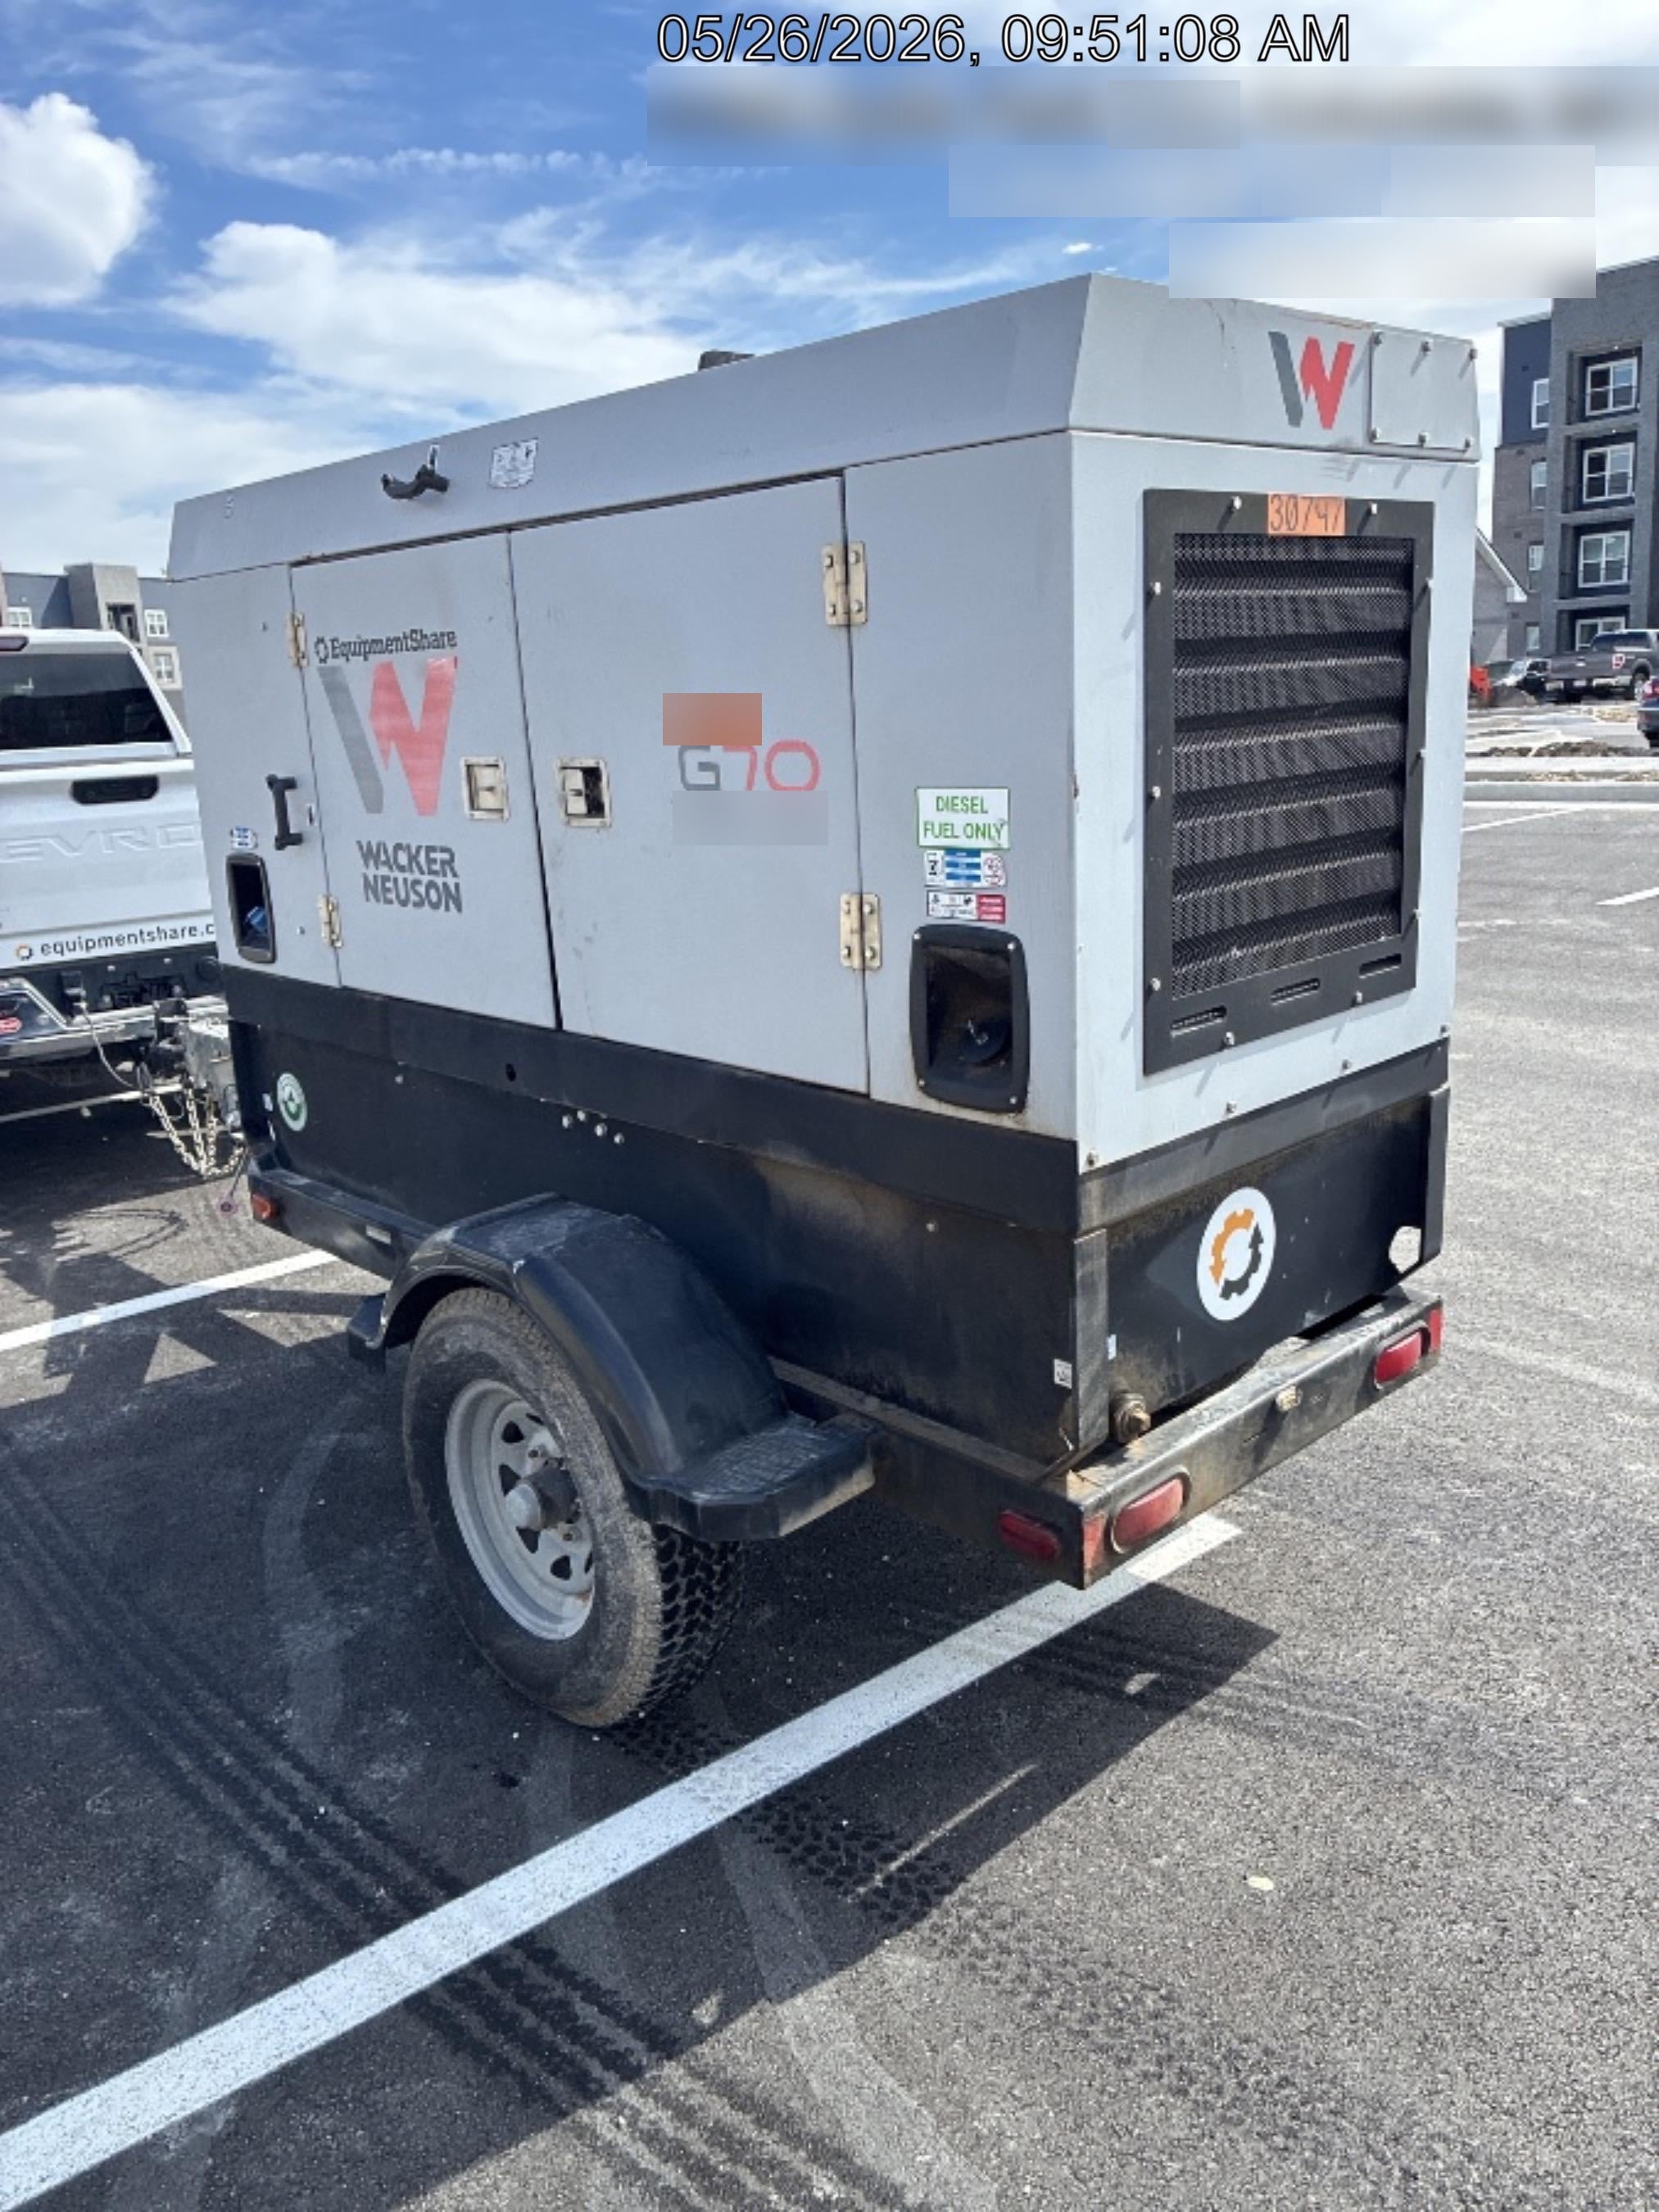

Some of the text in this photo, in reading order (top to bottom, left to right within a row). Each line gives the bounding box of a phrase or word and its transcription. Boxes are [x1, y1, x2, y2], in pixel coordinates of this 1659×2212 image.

[330, 628, 457, 663] EquipmentShare
[936, 796, 989, 814] DIESEL
[923, 821, 1004, 842] FUEL ONLY
[356, 840, 460, 878] WACKER
[362, 871, 463, 914] NEUSON
